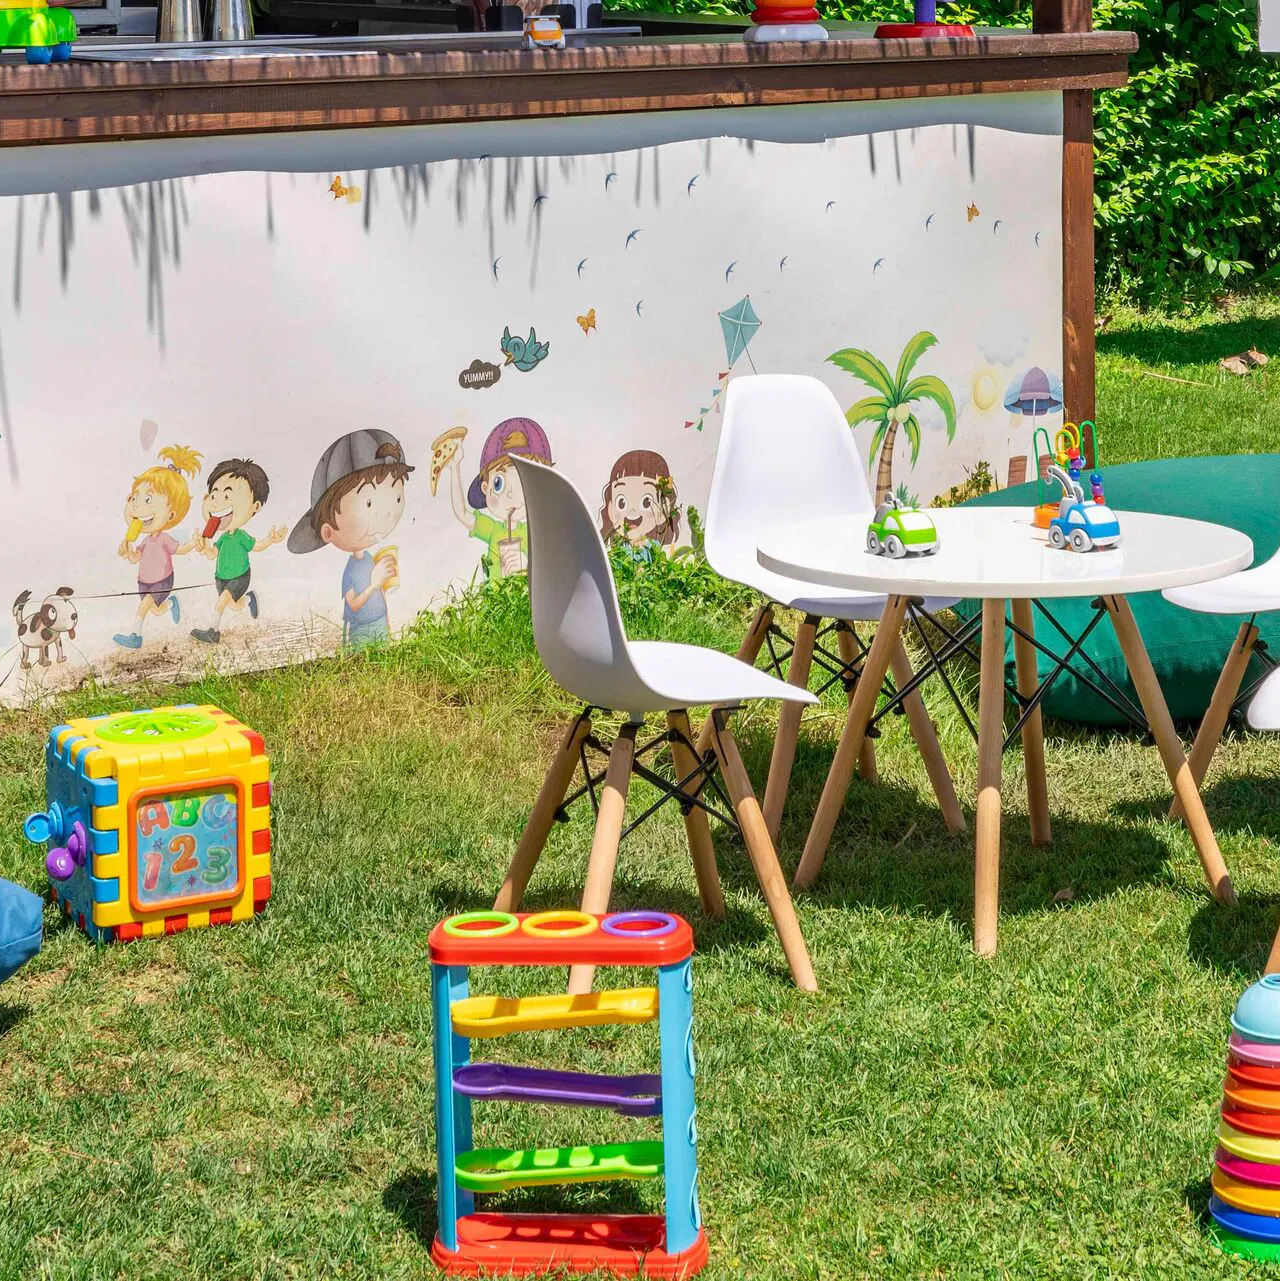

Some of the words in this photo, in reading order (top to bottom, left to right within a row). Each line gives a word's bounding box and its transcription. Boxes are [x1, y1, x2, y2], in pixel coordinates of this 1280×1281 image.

[463, 371, 494, 383] YUMMY!!
[138, 793, 236, 837] ABC
[143, 834, 232, 890] 123
